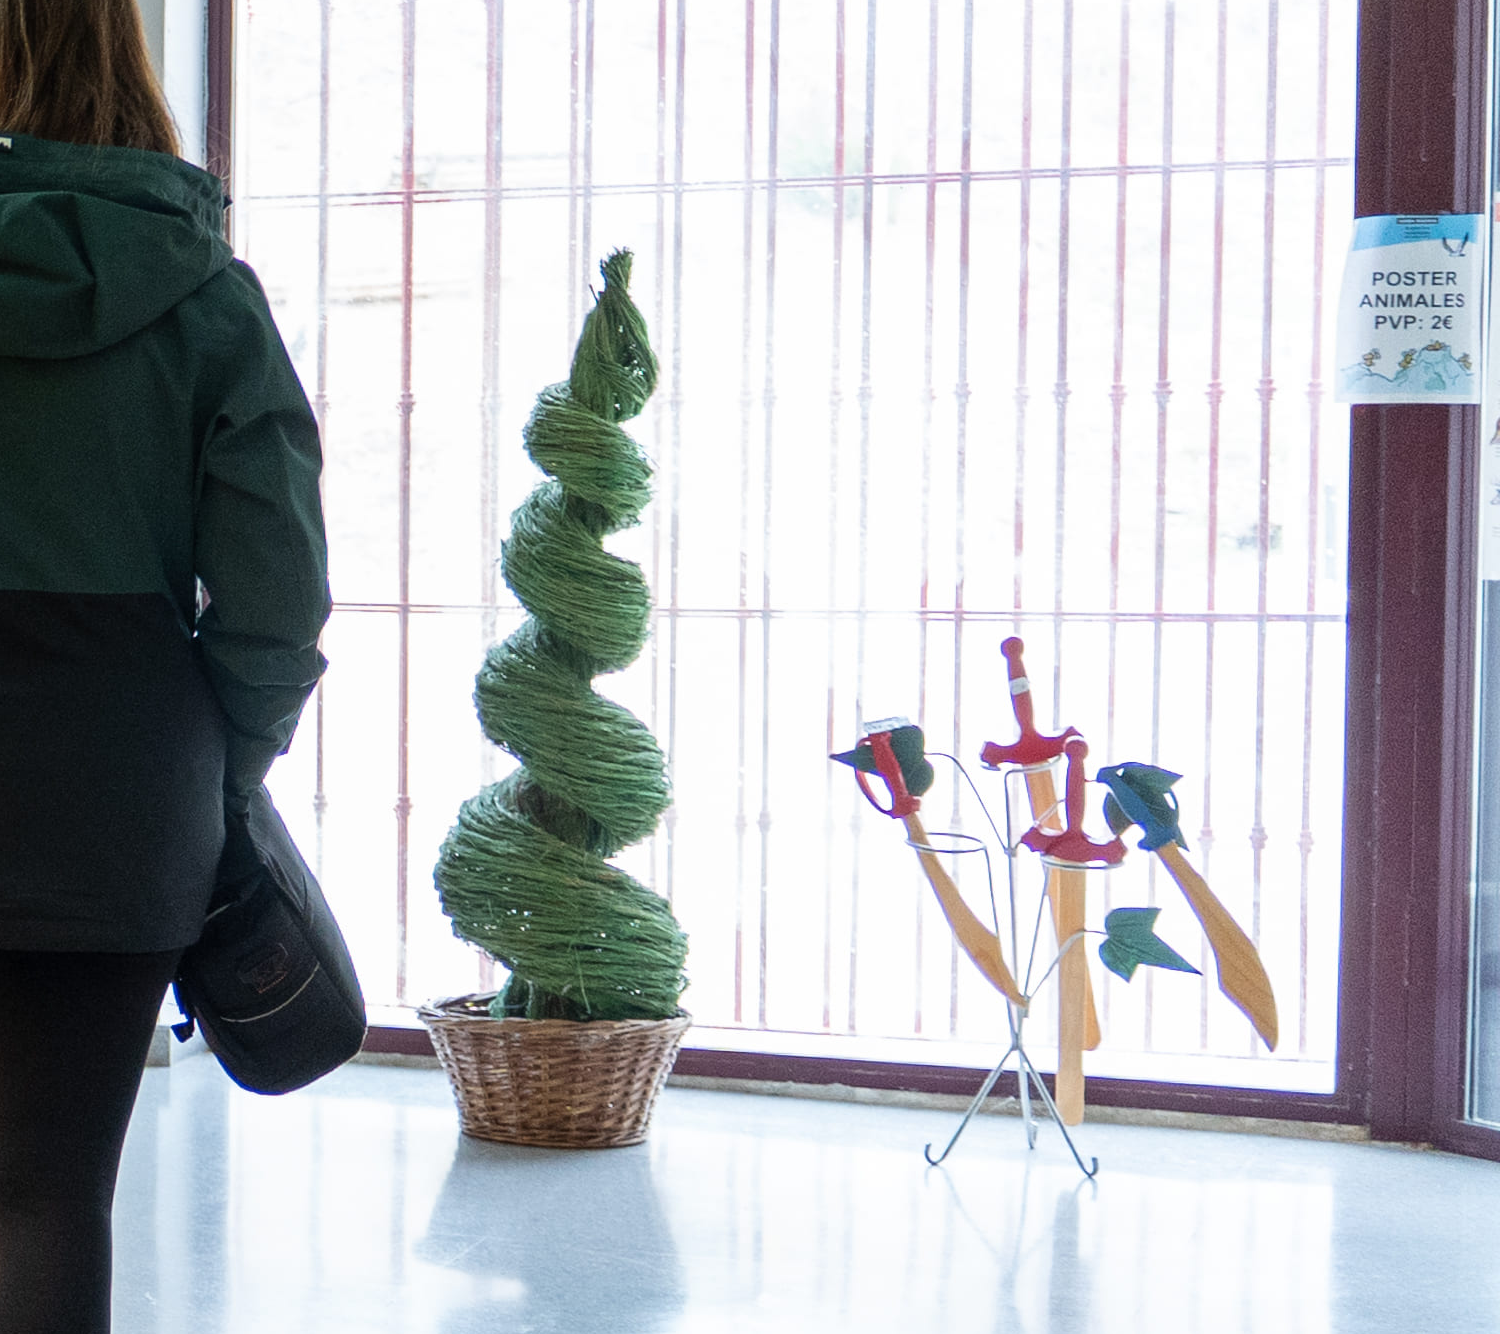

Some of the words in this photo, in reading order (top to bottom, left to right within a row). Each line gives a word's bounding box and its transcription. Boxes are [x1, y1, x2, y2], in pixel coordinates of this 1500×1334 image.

[1372, 271, 1457, 286] POSTER
[1359, 293, 1465, 308] ANIMALES
[1374, 315, 1423, 330] PVP:
[1431, 315, 1454, 330] 2€
